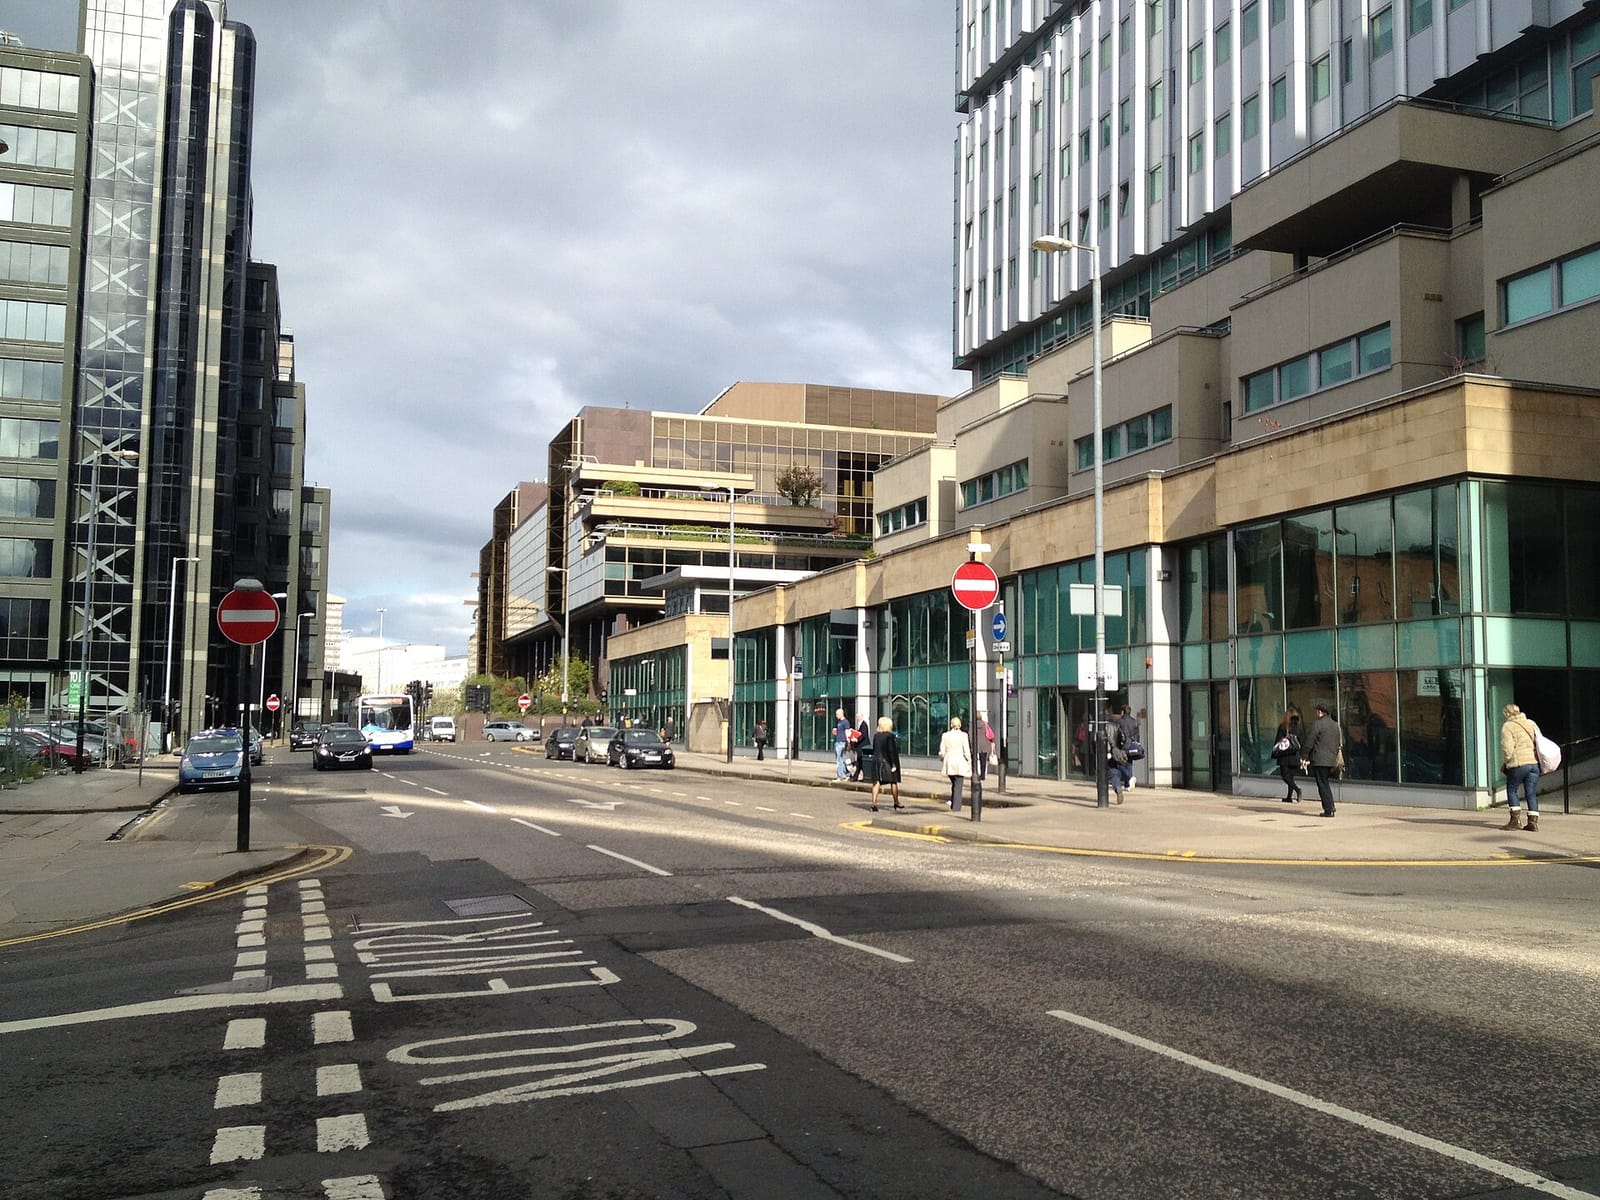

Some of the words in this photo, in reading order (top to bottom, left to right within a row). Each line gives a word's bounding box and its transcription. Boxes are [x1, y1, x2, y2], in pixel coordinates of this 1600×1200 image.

[69, 671, 78, 683] TO
[78, 671, 90, 683] LT
[348, 913, 621, 1003] ENTRY
[386, 1018, 767, 1112] NO
